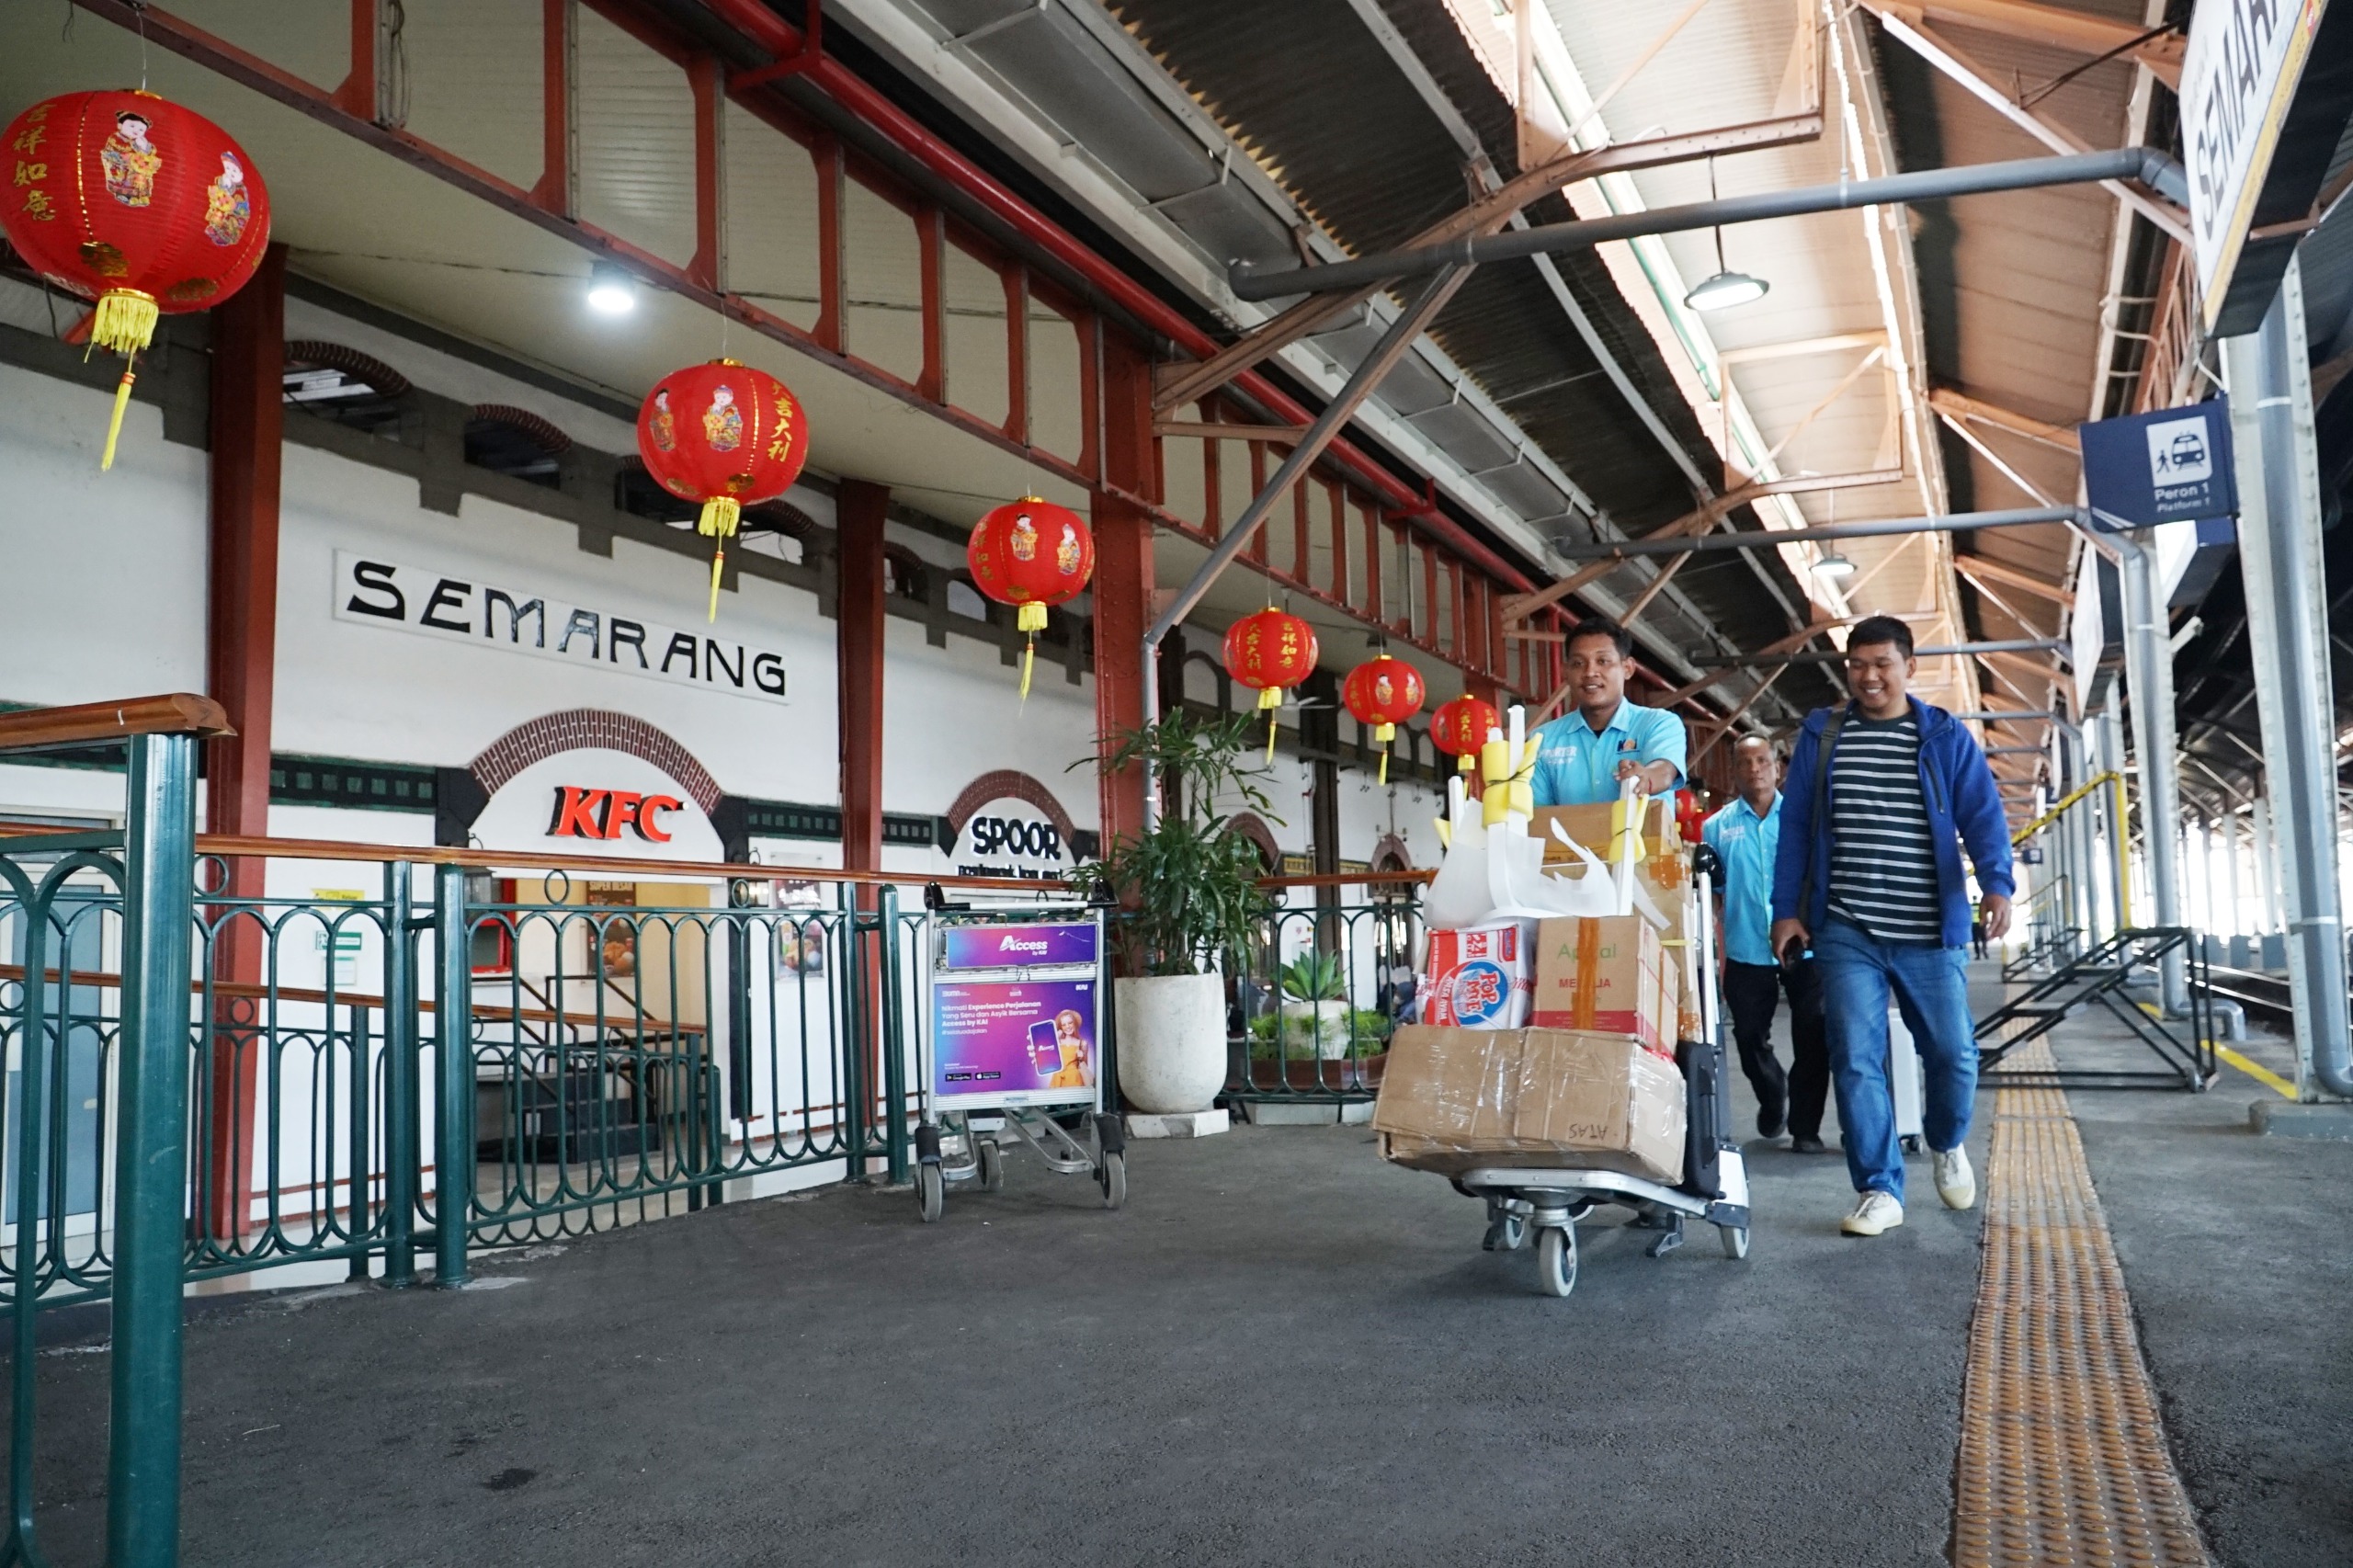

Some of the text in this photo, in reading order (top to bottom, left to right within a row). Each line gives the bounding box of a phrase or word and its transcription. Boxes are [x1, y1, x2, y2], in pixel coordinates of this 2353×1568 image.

[2154, 482, 2210, 501] Peron 1
[2157, 496, 2211, 512] Platform 1
[347, 561, 786, 696] SEMARANG
[549, 786, 679, 843] KFC
[972, 816, 1062, 860] SPOOR
[999, 936, 1048, 951] Access
[1480, 971, 1500, 1004] POP
[968, 1003, 1005, 1012] Experience
[967, 1019, 975, 1028] by
[1568, 1123, 1608, 1141] ATAS
